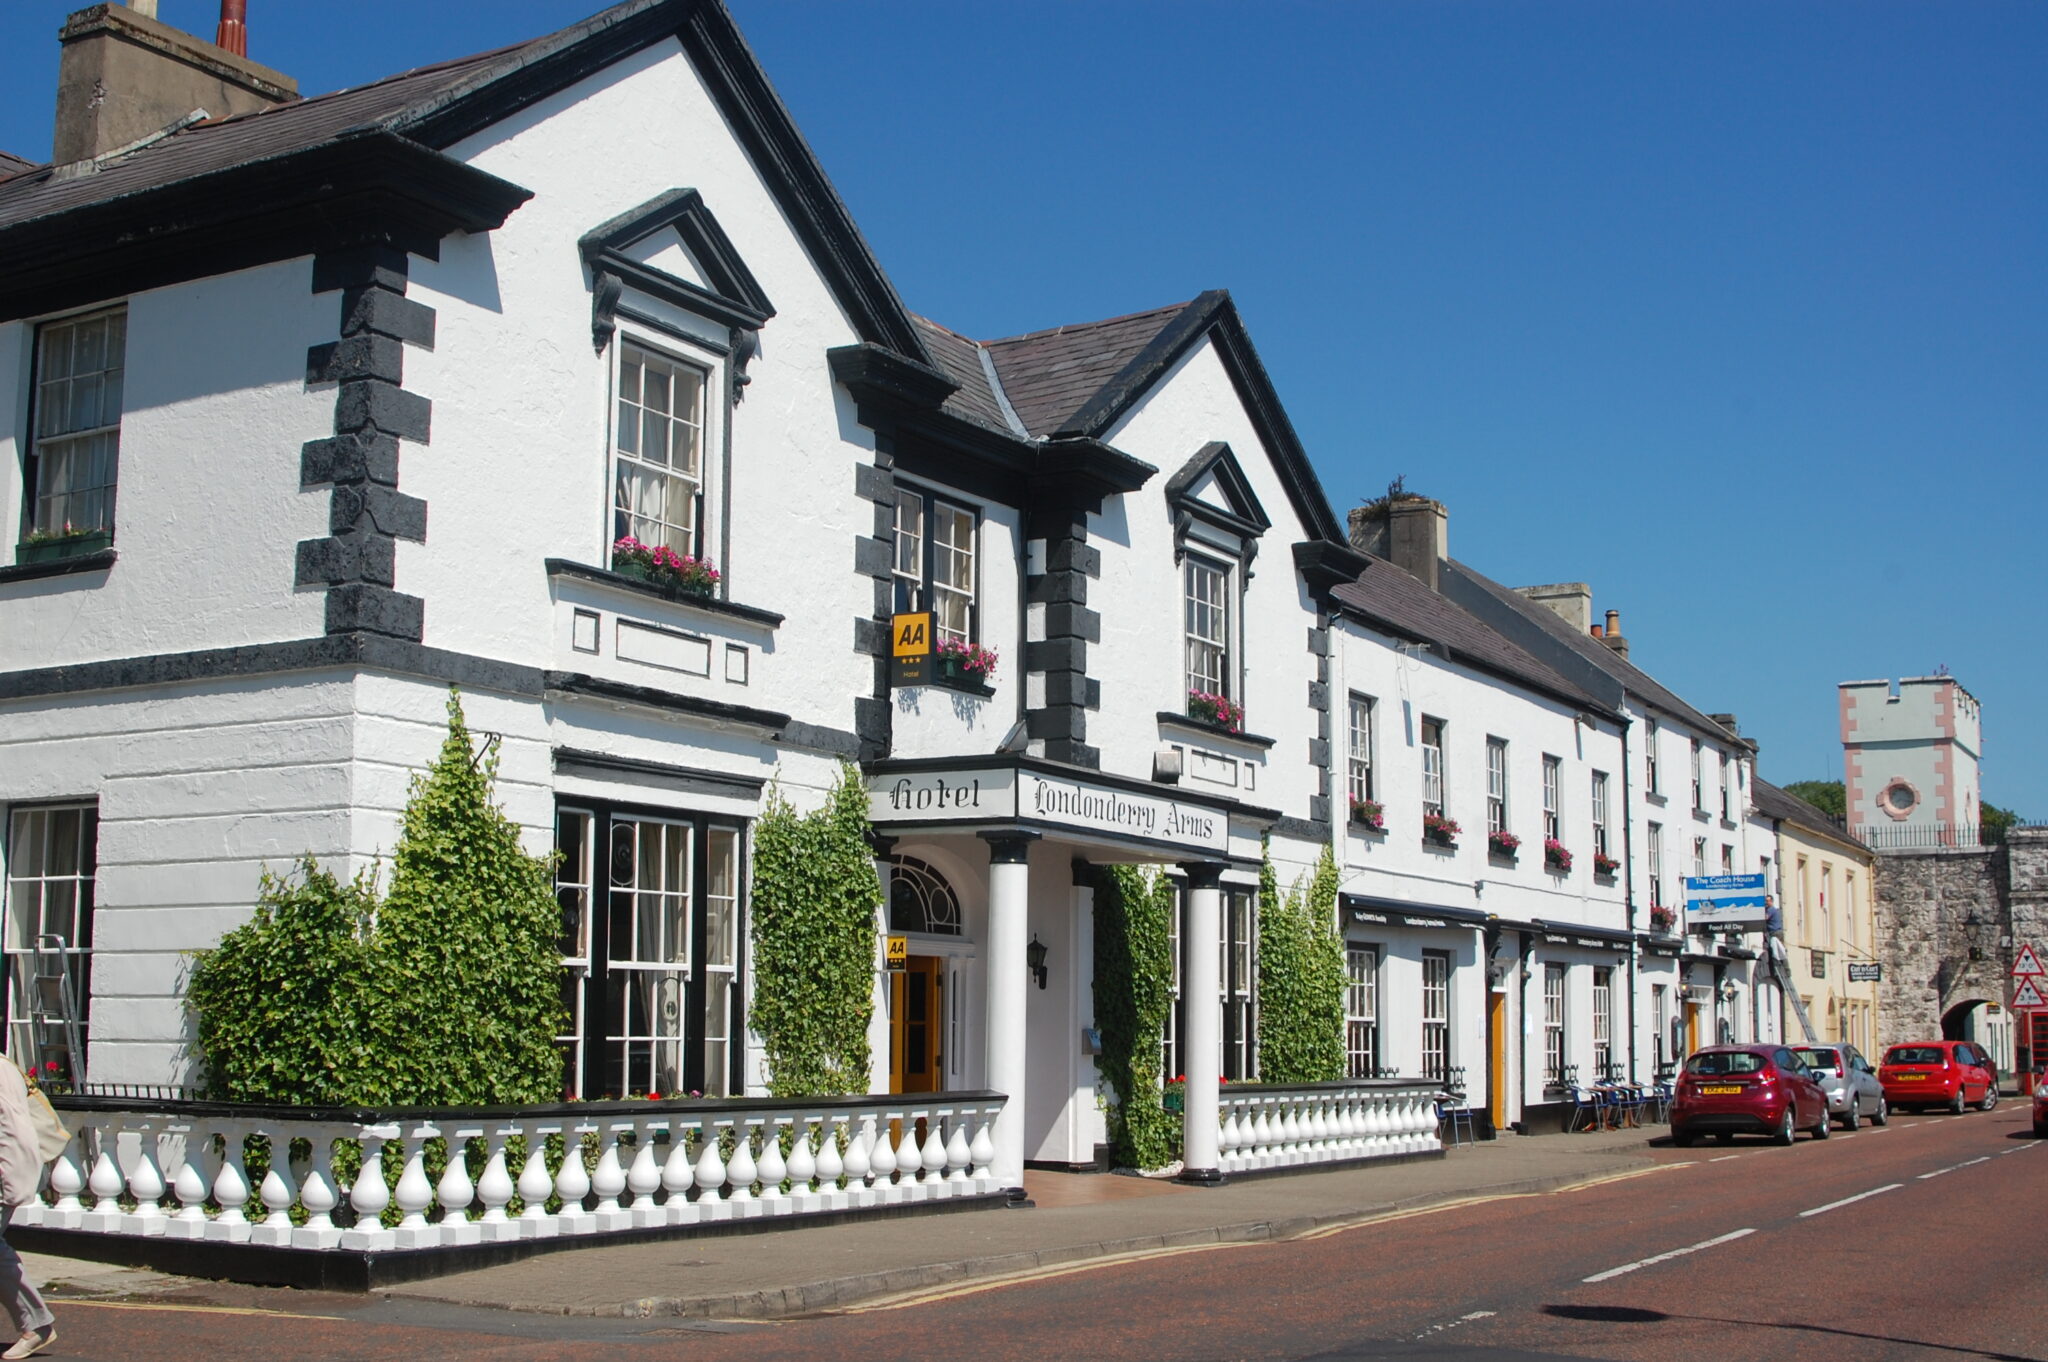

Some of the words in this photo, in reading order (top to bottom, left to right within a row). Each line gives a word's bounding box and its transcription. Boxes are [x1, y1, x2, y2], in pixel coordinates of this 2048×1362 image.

[898, 623, 924, 646] AA
[889, 778, 980, 810] Hotel
[1034, 776, 1156, 835] Londonderry
[1162, 802, 1213, 839] Arms
[1709, 876, 1731, 884] Coach
[1733, 923, 1744, 931] Day
[889, 941, 904, 954] AA
